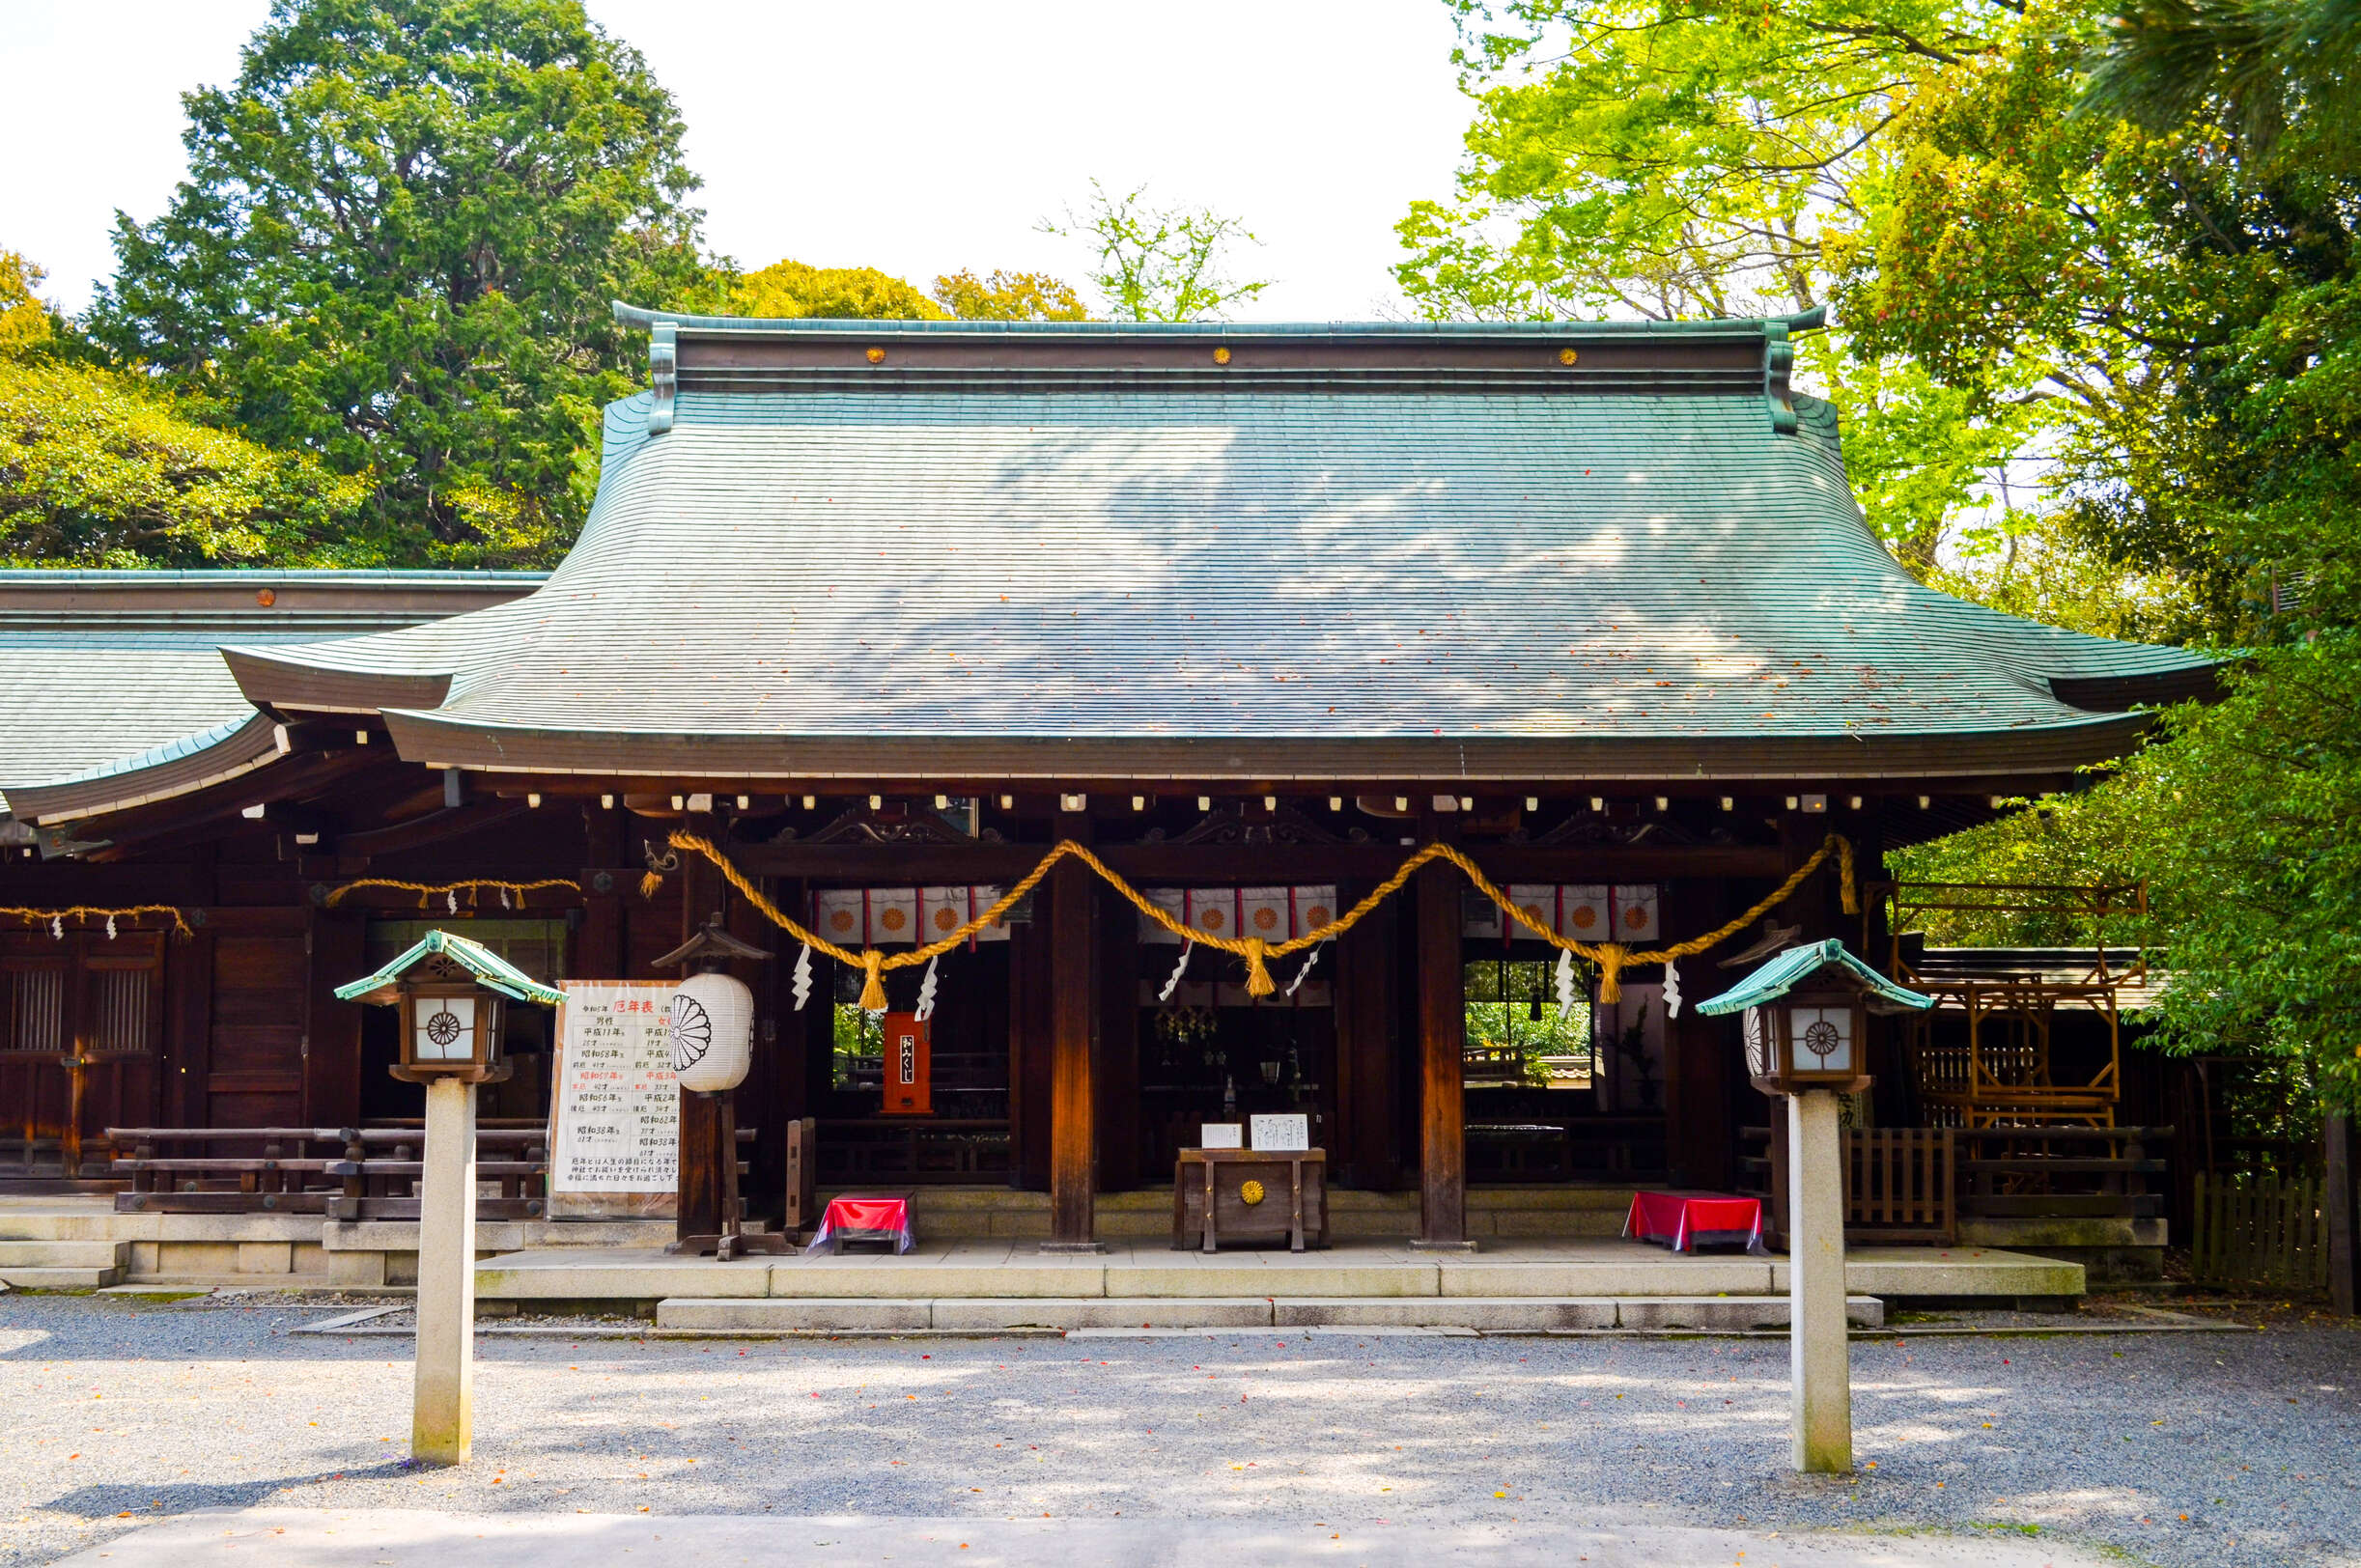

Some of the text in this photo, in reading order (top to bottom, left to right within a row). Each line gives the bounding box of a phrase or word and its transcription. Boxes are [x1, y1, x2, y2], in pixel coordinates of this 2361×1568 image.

[612, 999, 654, 1013] 厄年表
[596, 1017, 613, 1025] 男性
[659, 1017, 671, 1025] 女
[902, 1037, 913, 1082] おみくじ
[645, 1093, 679, 1103] 平成2年
